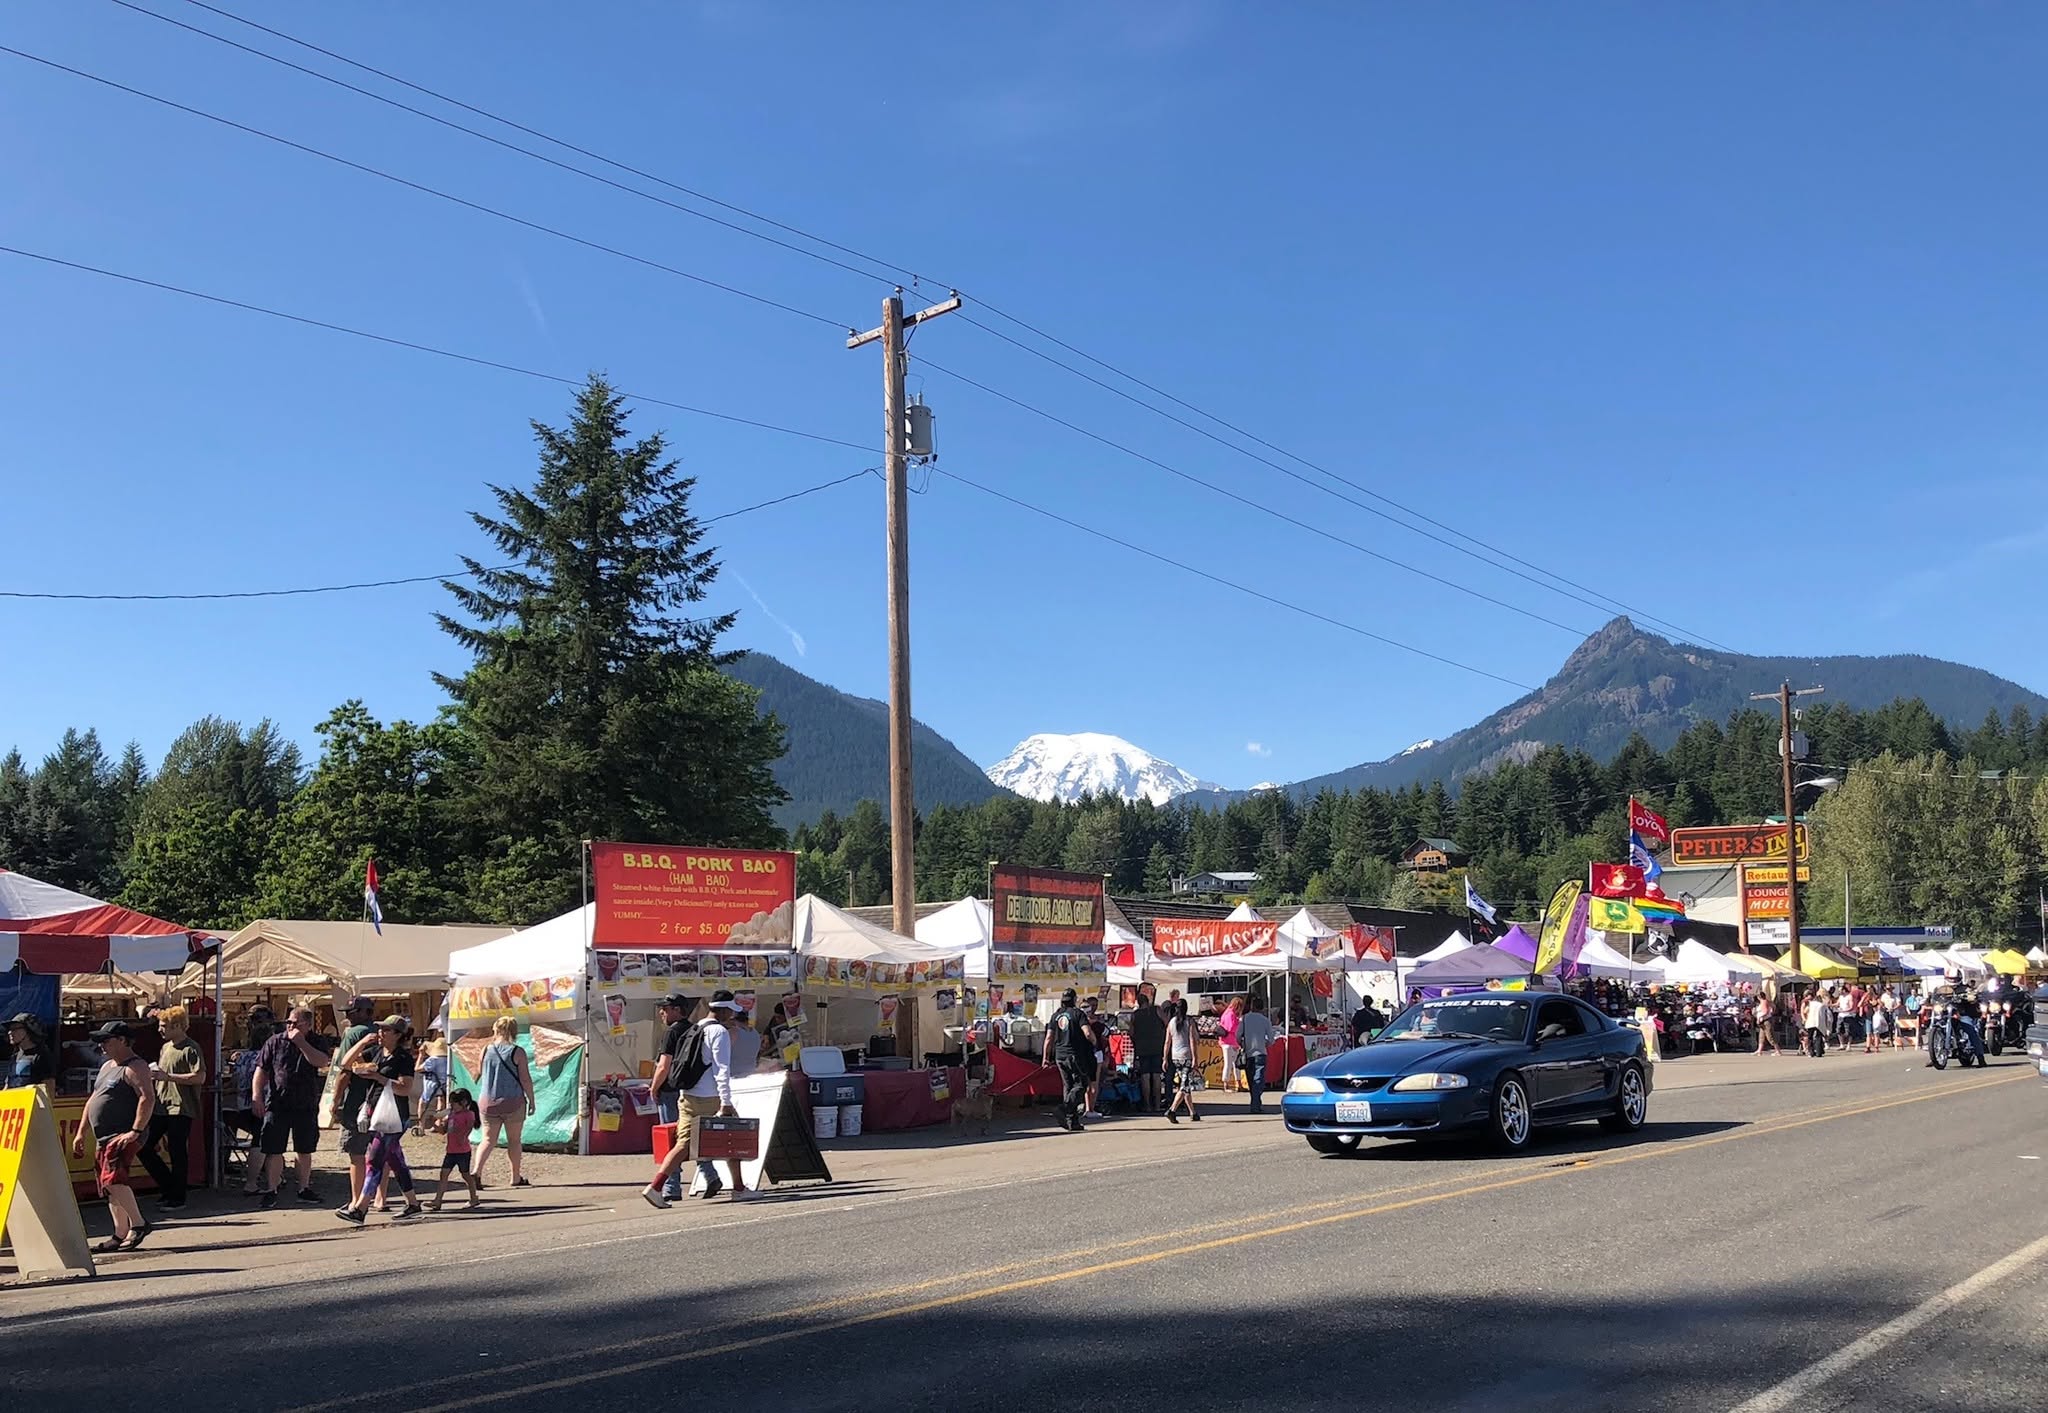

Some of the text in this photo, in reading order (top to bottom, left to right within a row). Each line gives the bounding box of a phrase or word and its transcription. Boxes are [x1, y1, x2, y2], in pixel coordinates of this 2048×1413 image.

[1680, 836, 1764, 856] PETERS
[623, 853, 776, 873] B.B.Q. PORK BAO
[669, 872, 730, 887] (HAM BAO)
[1746, 870, 1808, 881] Restaurnt
[613, 883, 642, 891] Steamed
[1748, 888, 1790, 897] LOUNGE
[1007, 895, 1051, 923] DELICIOUS
[1051, 898, 1074, 925] ASIA
[1750, 899, 1791, 910] MOTEL
[660, 923, 731, 936] 2 for $5.00
[1155, 926, 1175, 936] COOL
[1928, 928, 1952, 937] Mobil
[1424, 1000, 1471, 1008] WICKED
